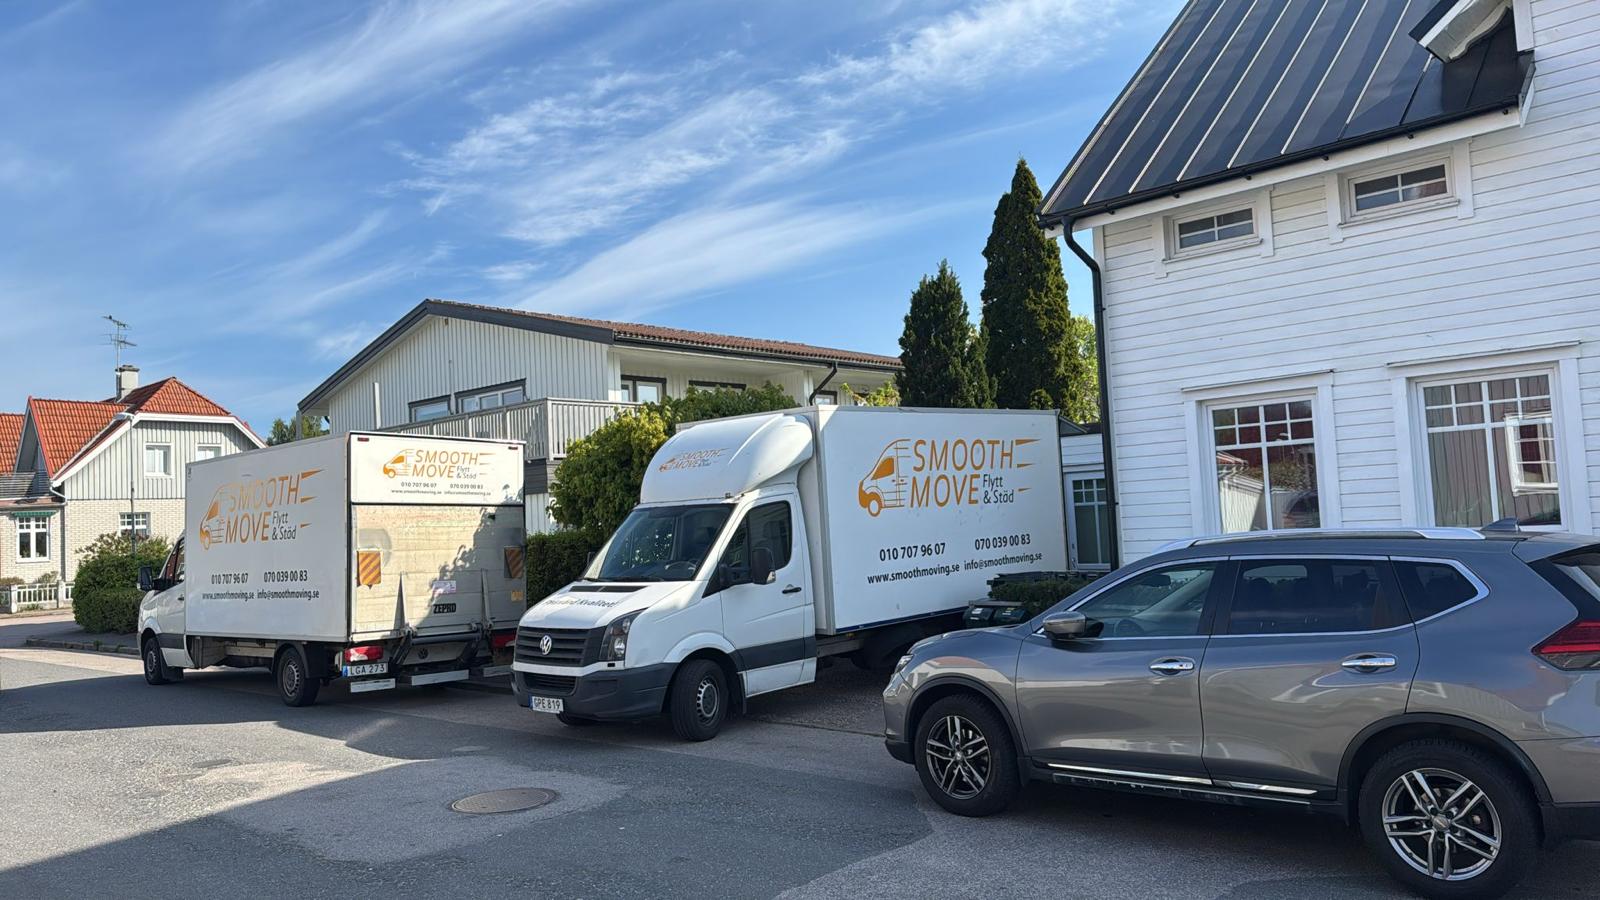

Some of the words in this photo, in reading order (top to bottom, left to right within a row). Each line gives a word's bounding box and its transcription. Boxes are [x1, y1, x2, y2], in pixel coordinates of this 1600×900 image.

[415, 449, 479, 466] SMOOTH
[913, 439, 1014, 472] SMOOTH
[412, 464, 457, 479] MOVE
[983, 473, 1003, 491] Flytt
[228, 474, 300, 513] SMOOTH
[910, 473, 981, 508] MOVE
[983, 491, 992, 504] &
[993, 489, 1014, 504] Stöd
[225, 511, 272, 543] MOVE
[272, 511, 288, 527] Flytt
[272, 531, 278, 541] &
[279, 525, 297, 540] Stöd
[975, 537, 990, 550] 070
[992, 535, 1008, 548] 039
[1009, 534, 1020, 547] 00
[1021, 533, 1031, 545] 83
[879, 548, 898, 561] 010
[901, 545, 918, 559] 707
[920, 544, 933, 557] 96
[934, 542, 946, 555] 07
[867, 563, 960, 584] www.smoothmoving.se
[964, 551, 1042, 570] info@smoothmoving.se
[211, 573, 221, 584] 010
[222, 573, 232, 584] 707
[233, 573, 241, 584] 96
[241, 572, 249, 583] 07
[263, 571, 276, 583] 070
[277, 570, 289, 582] 039
[289, 570, 298, 582] 00
[299, 570, 308, 581] 83
[202, 590, 254, 602] www.smoothmoving.se
[257, 588, 319, 601] info@smoothmoving.se
[433, 603, 456, 613] ZEPRO
[351, 665, 366, 675] LGA
[369, 664, 385, 673] 273
[534, 697, 546, 708] GPE
[548, 699, 560, 709] 819
